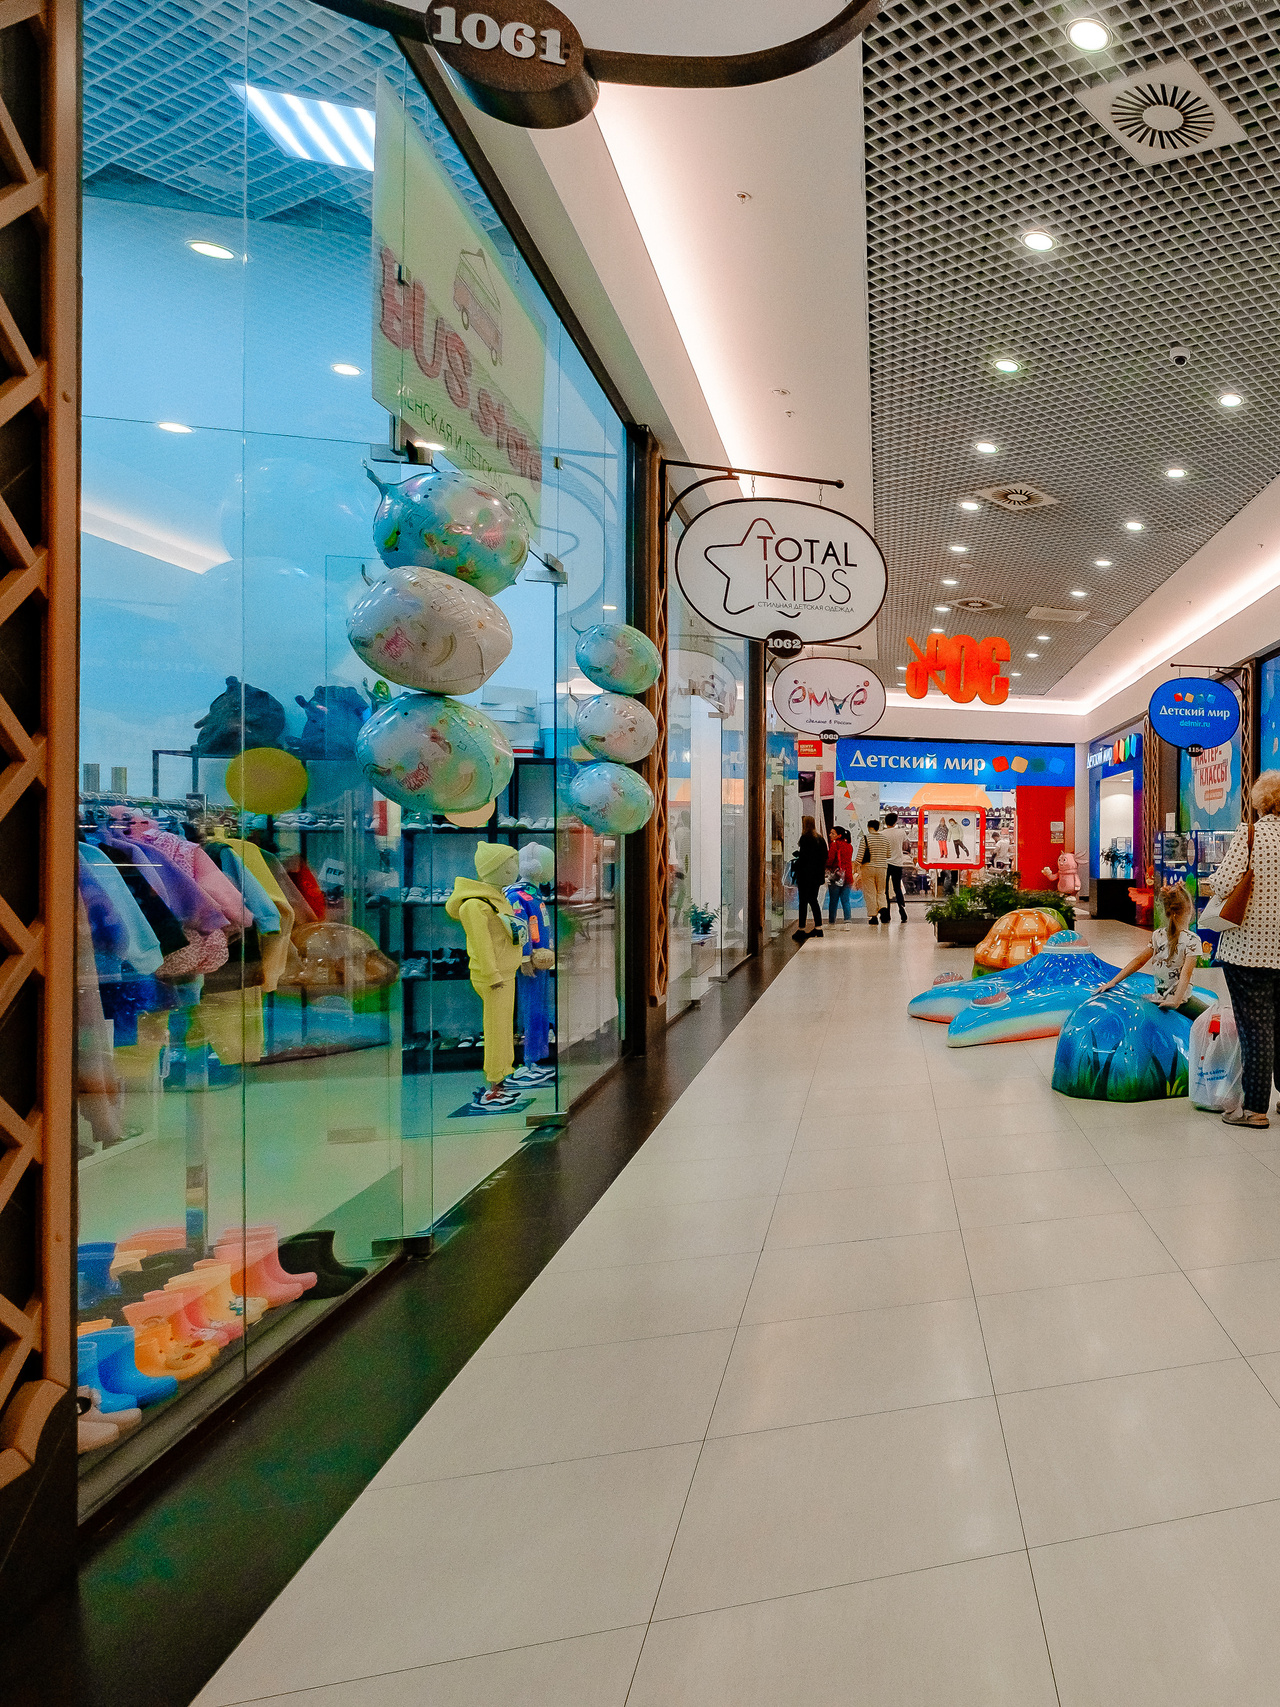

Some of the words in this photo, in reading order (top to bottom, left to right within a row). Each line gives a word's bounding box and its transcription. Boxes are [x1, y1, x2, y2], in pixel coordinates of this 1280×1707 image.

[433, 6, 566, 66] 1061
[757, 535, 858, 567] TOTAL
[765, 563, 852, 605] KIDS
[757, 601, 793, 609] СТИЛЬНАЯ
[824, 605, 855, 613] ОДЕЖДА
[767, 638, 801, 649] 1062
[1159, 705, 1205, 717] Детский
[1207, 709, 1231, 720] мир
[1179, 719, 1211, 728] detmir.ru
[849, 750, 938, 769] Детский
[943, 756, 986, 776] мир
[1199, 764, 1227, 786] КЛАССЫ
